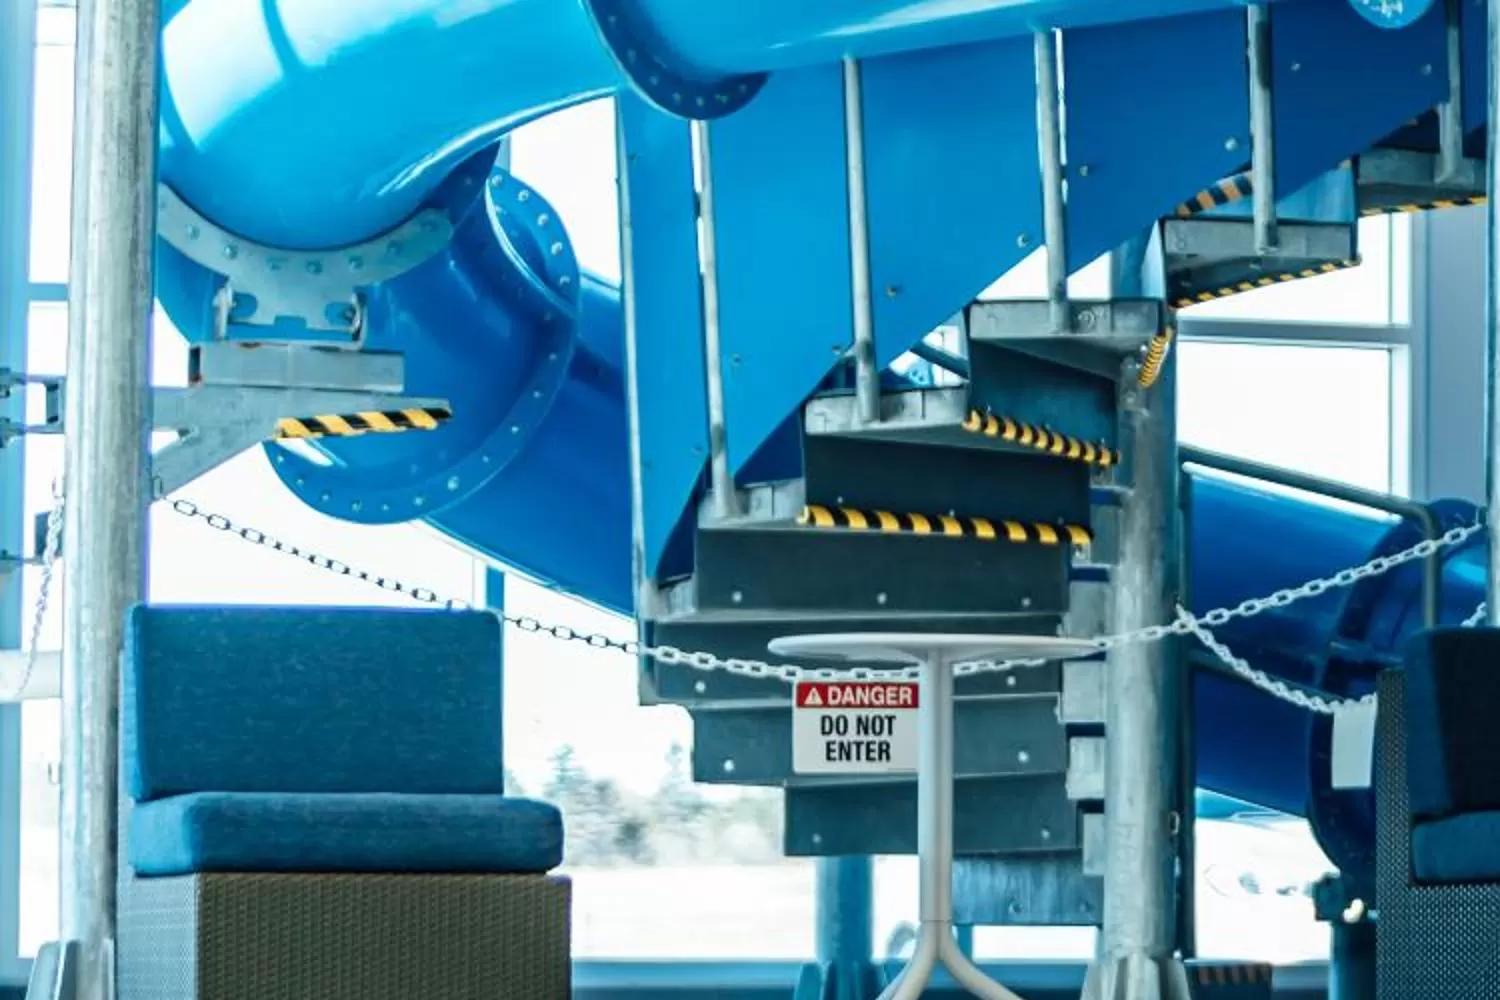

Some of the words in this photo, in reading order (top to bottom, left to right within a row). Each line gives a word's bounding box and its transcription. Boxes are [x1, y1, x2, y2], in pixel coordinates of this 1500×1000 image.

[827, 686, 913, 705] DANGER
[820, 715, 849, 736] DO
[856, 715, 897, 736] NOT
[825, 741, 891, 761] ENTER
